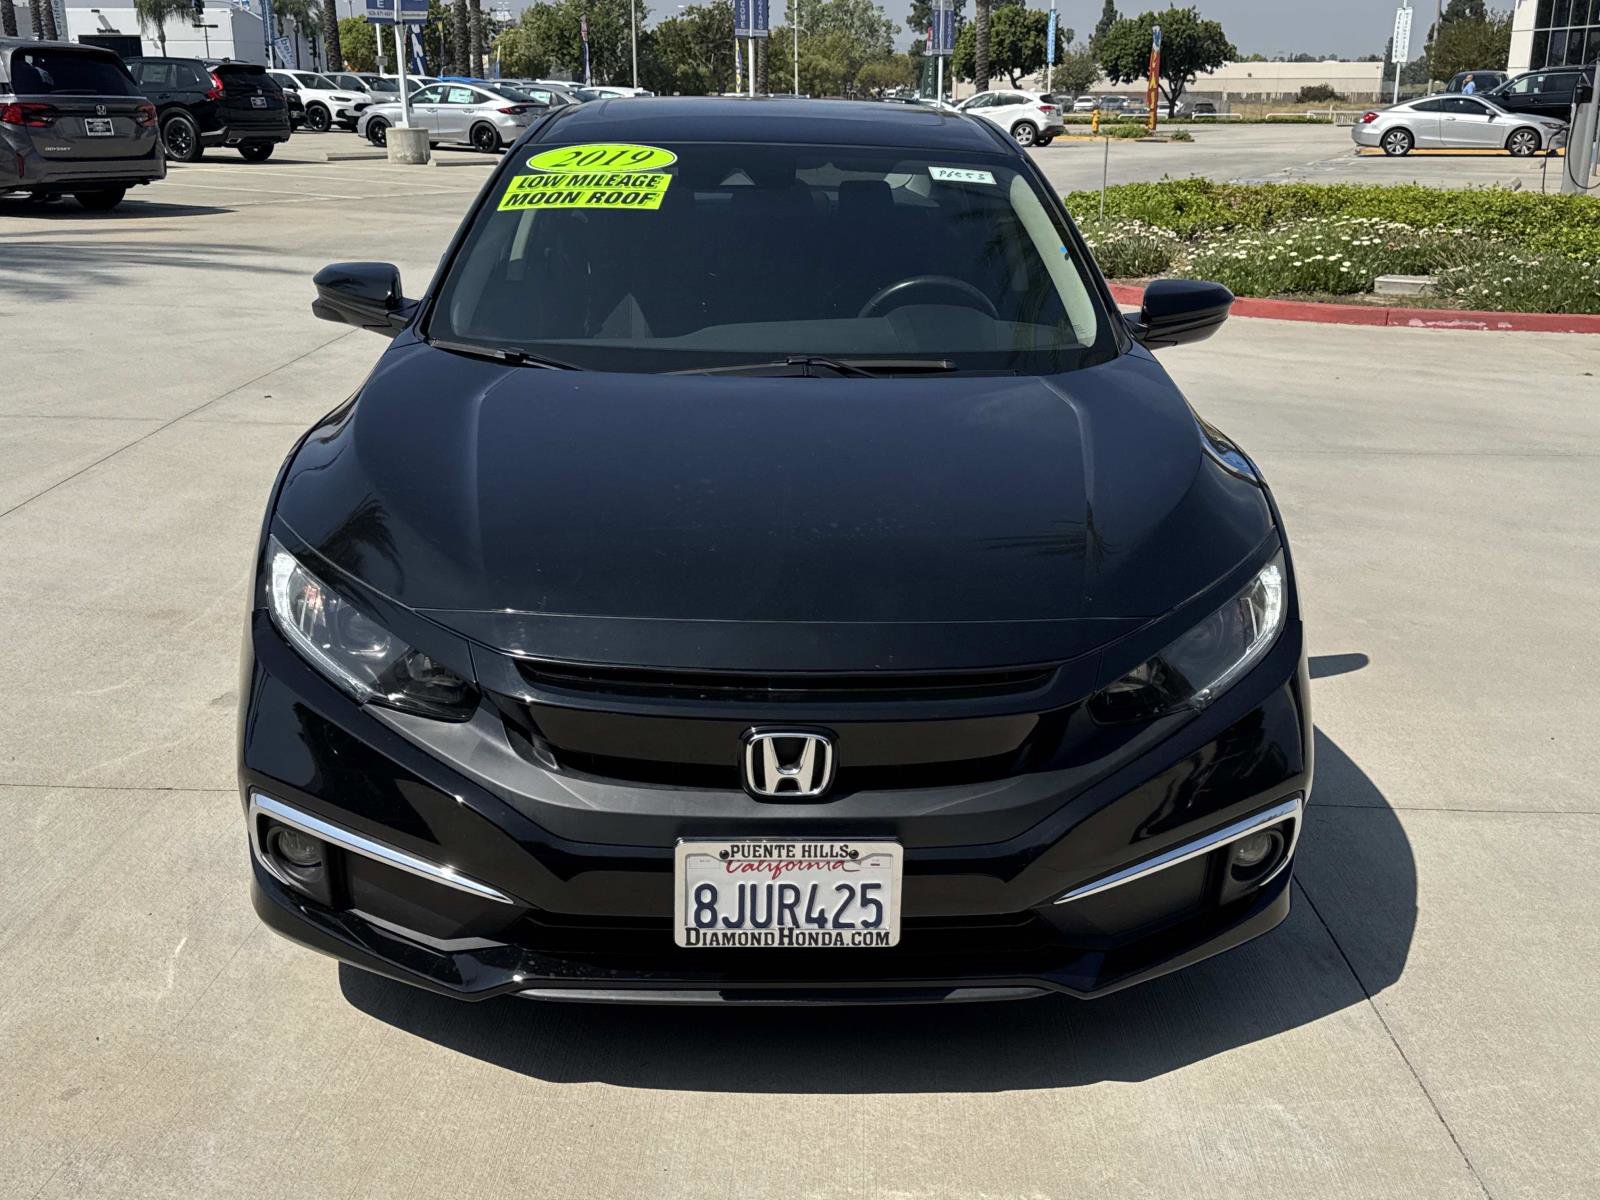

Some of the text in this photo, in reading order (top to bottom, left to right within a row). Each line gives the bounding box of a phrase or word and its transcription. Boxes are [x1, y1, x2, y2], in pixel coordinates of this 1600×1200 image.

[552, 149, 655, 167] 2019
[516, 174, 662, 190] LOW MILEAGE
[505, 191, 658, 207] MOON ROOF
[730, 844, 850, 858] PUENTE HILLS
[726, 859, 861, 880] California
[693, 882, 884, 930] 8JUR425
